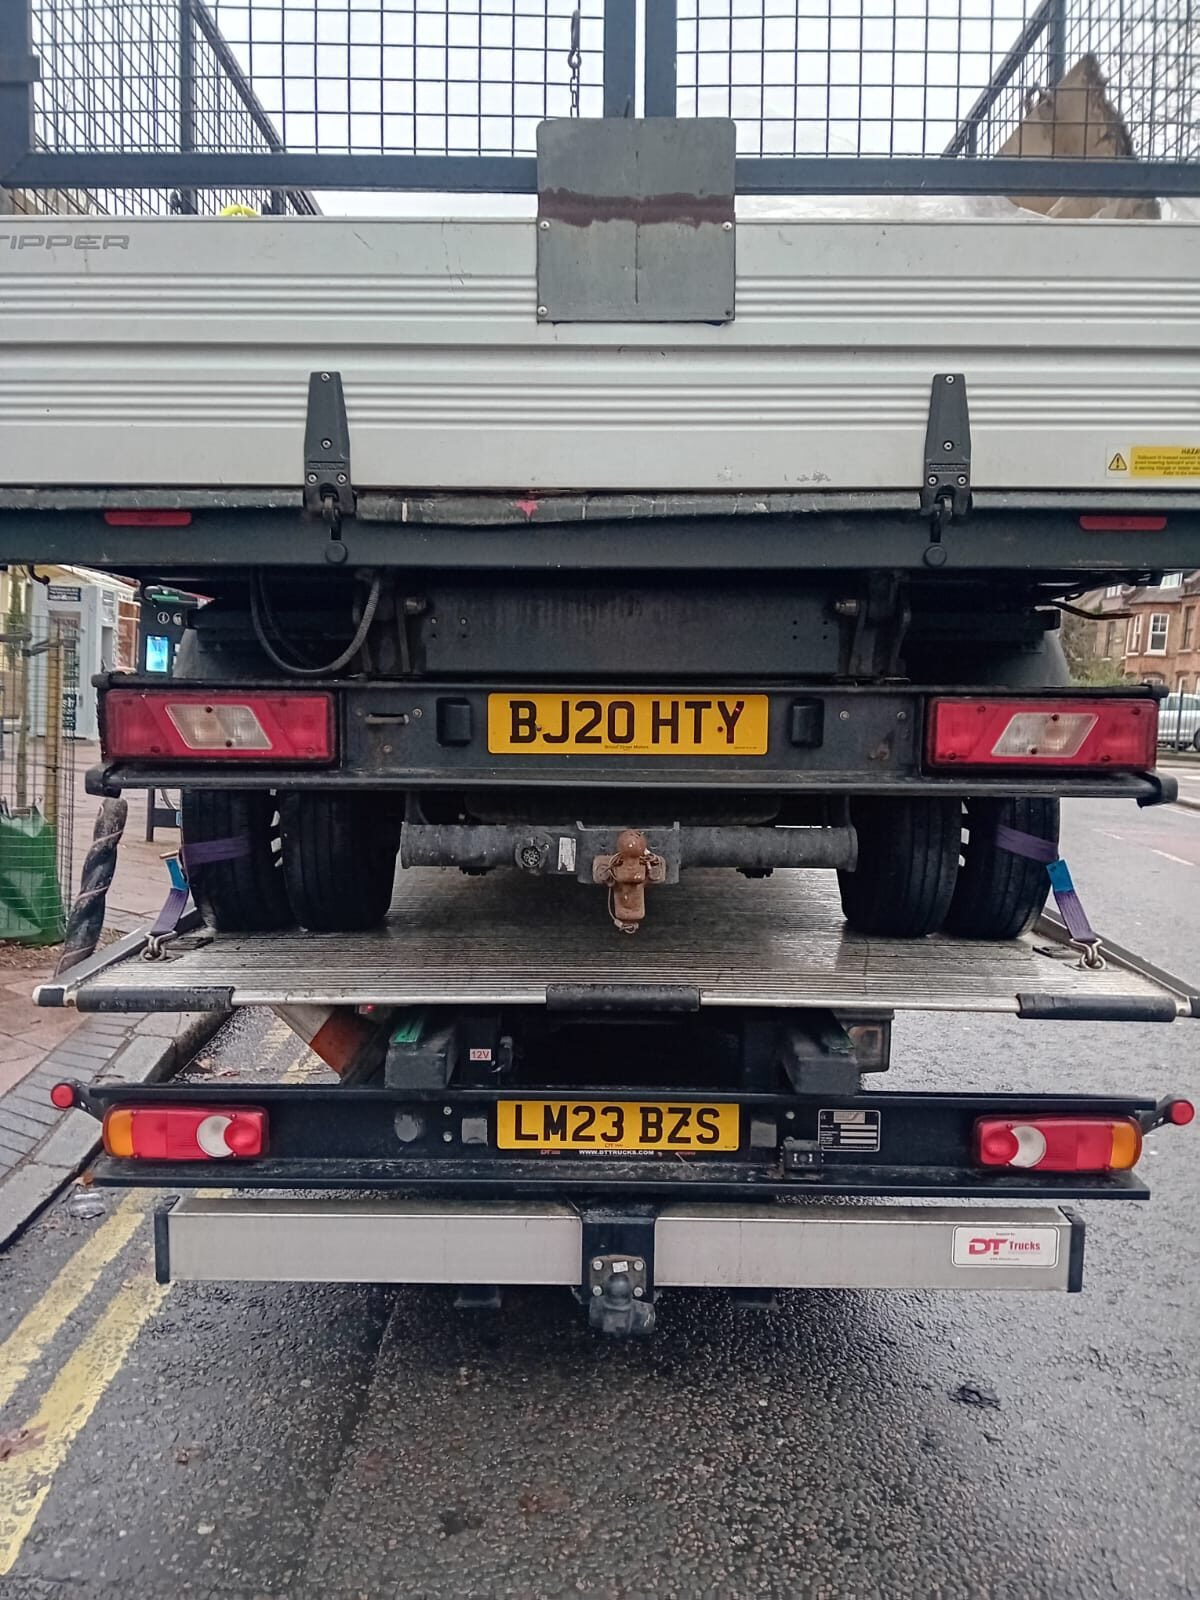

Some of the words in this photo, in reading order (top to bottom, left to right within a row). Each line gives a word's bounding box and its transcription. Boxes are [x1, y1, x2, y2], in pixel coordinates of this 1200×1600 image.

[509, 700, 635, 744] BJ20
[651, 700, 745, 744] HTY
[471, 1050, 490, 1059] 12V
[514, 1104, 625, 1143] LM23
[639, 1106, 721, 1145] BZS
[968, 1238, 1009, 1255] DT
[1009, 1240, 1041, 1251] Trucks
